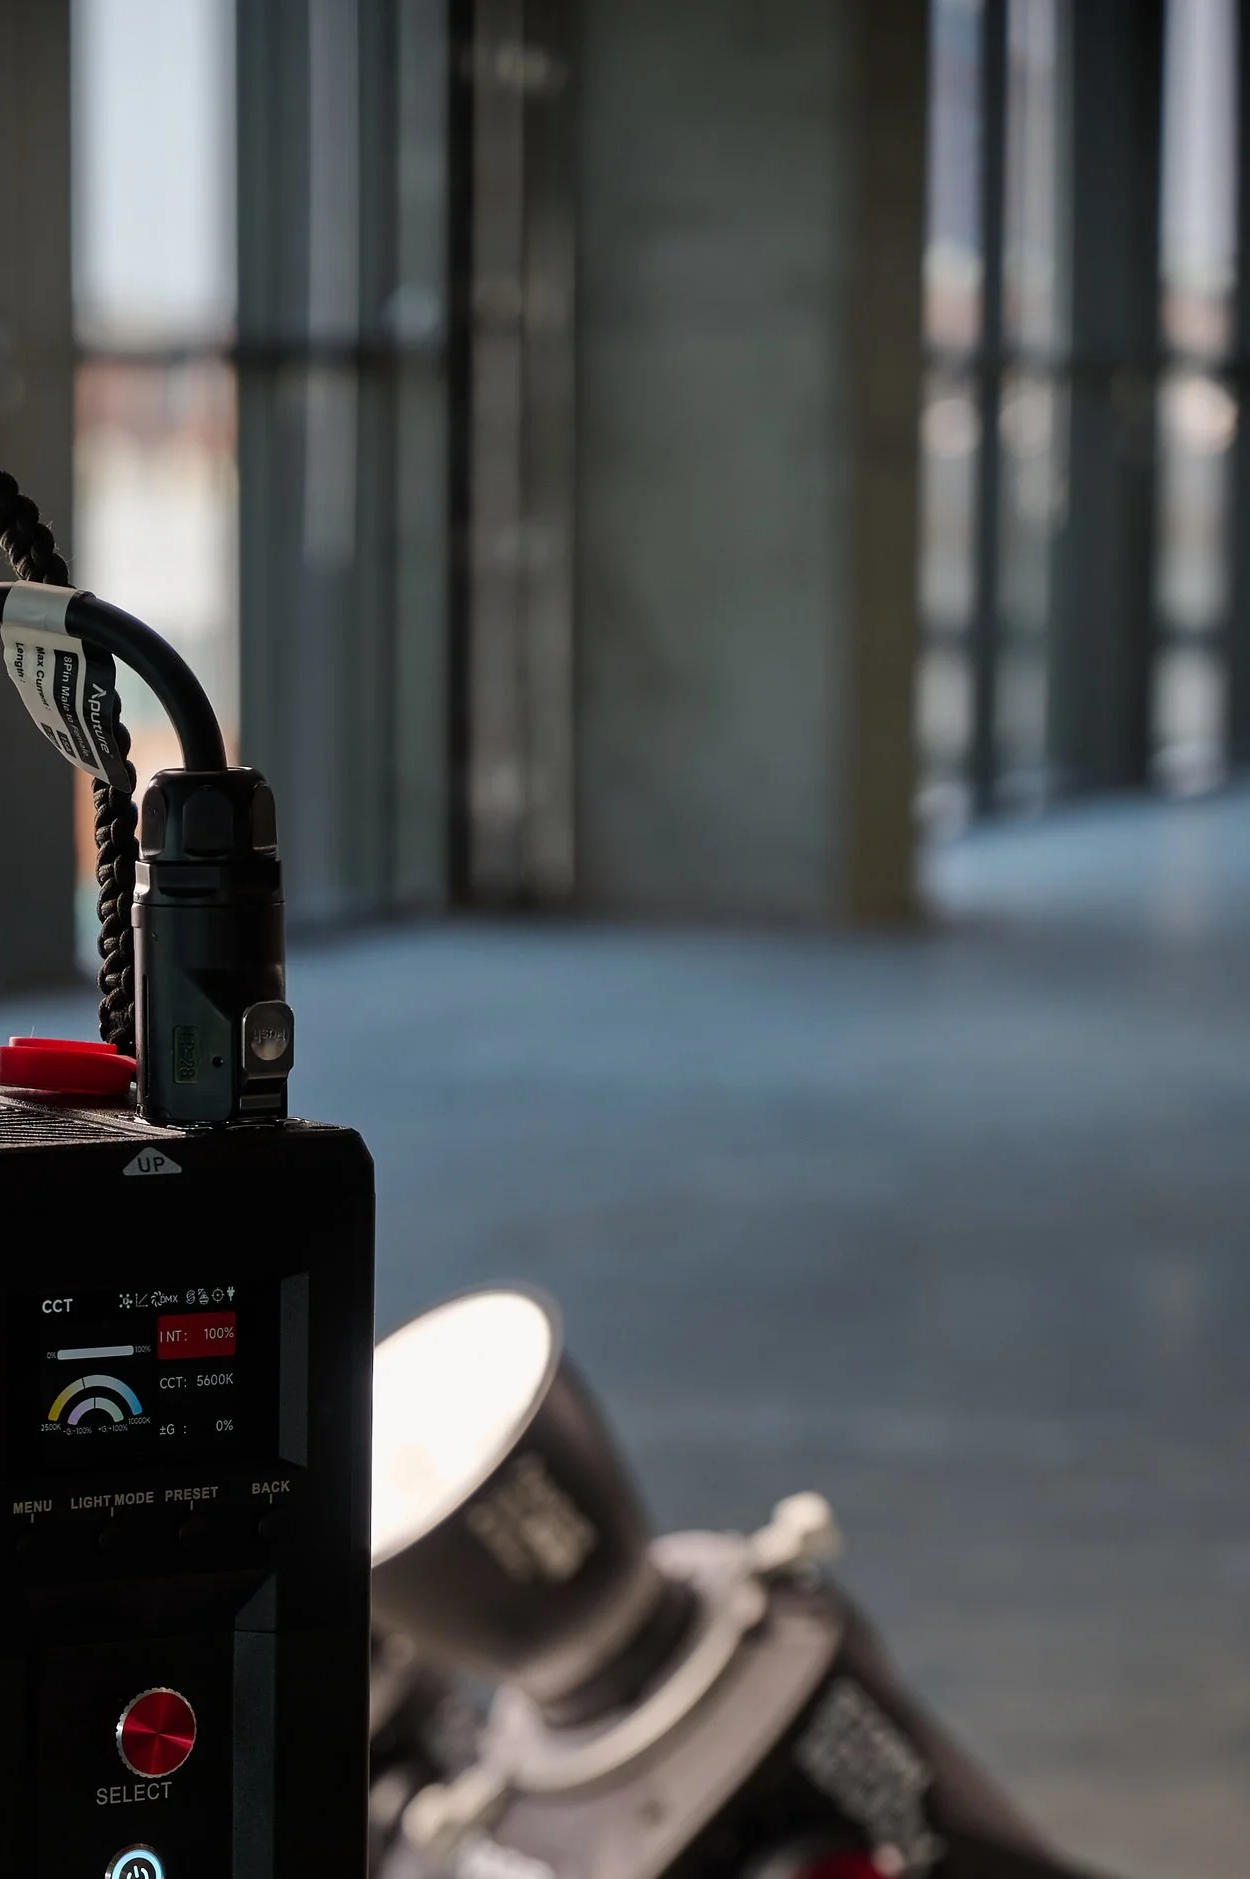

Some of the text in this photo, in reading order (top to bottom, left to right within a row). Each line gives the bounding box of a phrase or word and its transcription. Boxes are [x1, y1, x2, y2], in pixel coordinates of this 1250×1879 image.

[35, 646, 46, 668] Max
[62, 655, 73, 683] 8Pin
[61, 685, 71, 712] Male
[88, 682, 111, 755] Aputure
[137, 1156, 165, 1173] UP
[41, 1298, 74, 1314] CCT
[204, 1326, 235, 1340] 100%
[159, 1372, 234, 1390] CCT: 5600K
[215, 1419, 234, 1432] 0%
[164, 1486, 219, 1502] PRESET
[251, 1480, 291, 1495] BACK
[12, 1500, 53, 1515] MENU
[70, 1491, 155, 1510] LIGHT MODE
[95, 1781, 173, 1806] SELECT
